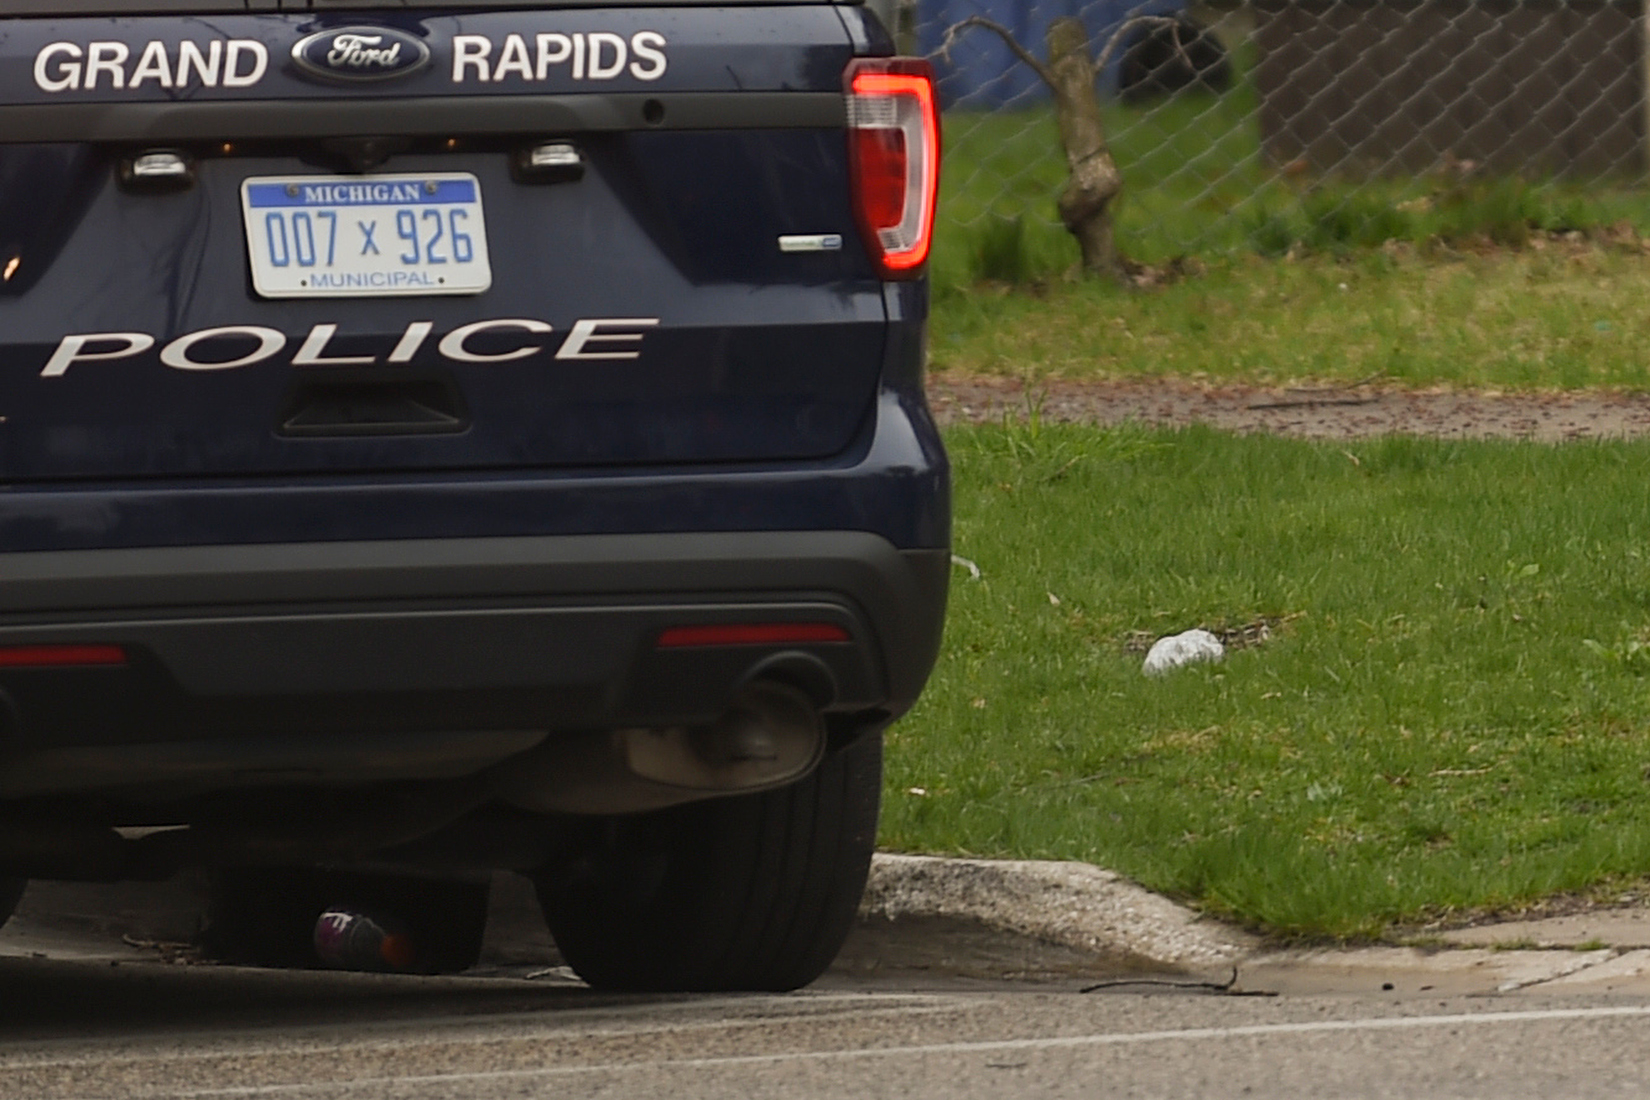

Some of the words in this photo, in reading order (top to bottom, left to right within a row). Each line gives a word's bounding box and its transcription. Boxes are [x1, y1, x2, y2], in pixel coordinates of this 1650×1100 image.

[33, 39, 269, 91] GRAND
[452, 32, 668, 82] RAPIDS
[327, 34, 401, 66] Ford
[304, 184, 421, 204] MICHIGAN
[265, 210, 337, 267] 007
[396, 208, 474, 265] 926
[309, 271, 435, 288] MUNICIPAL
[40, 318, 660, 378] POLICE
